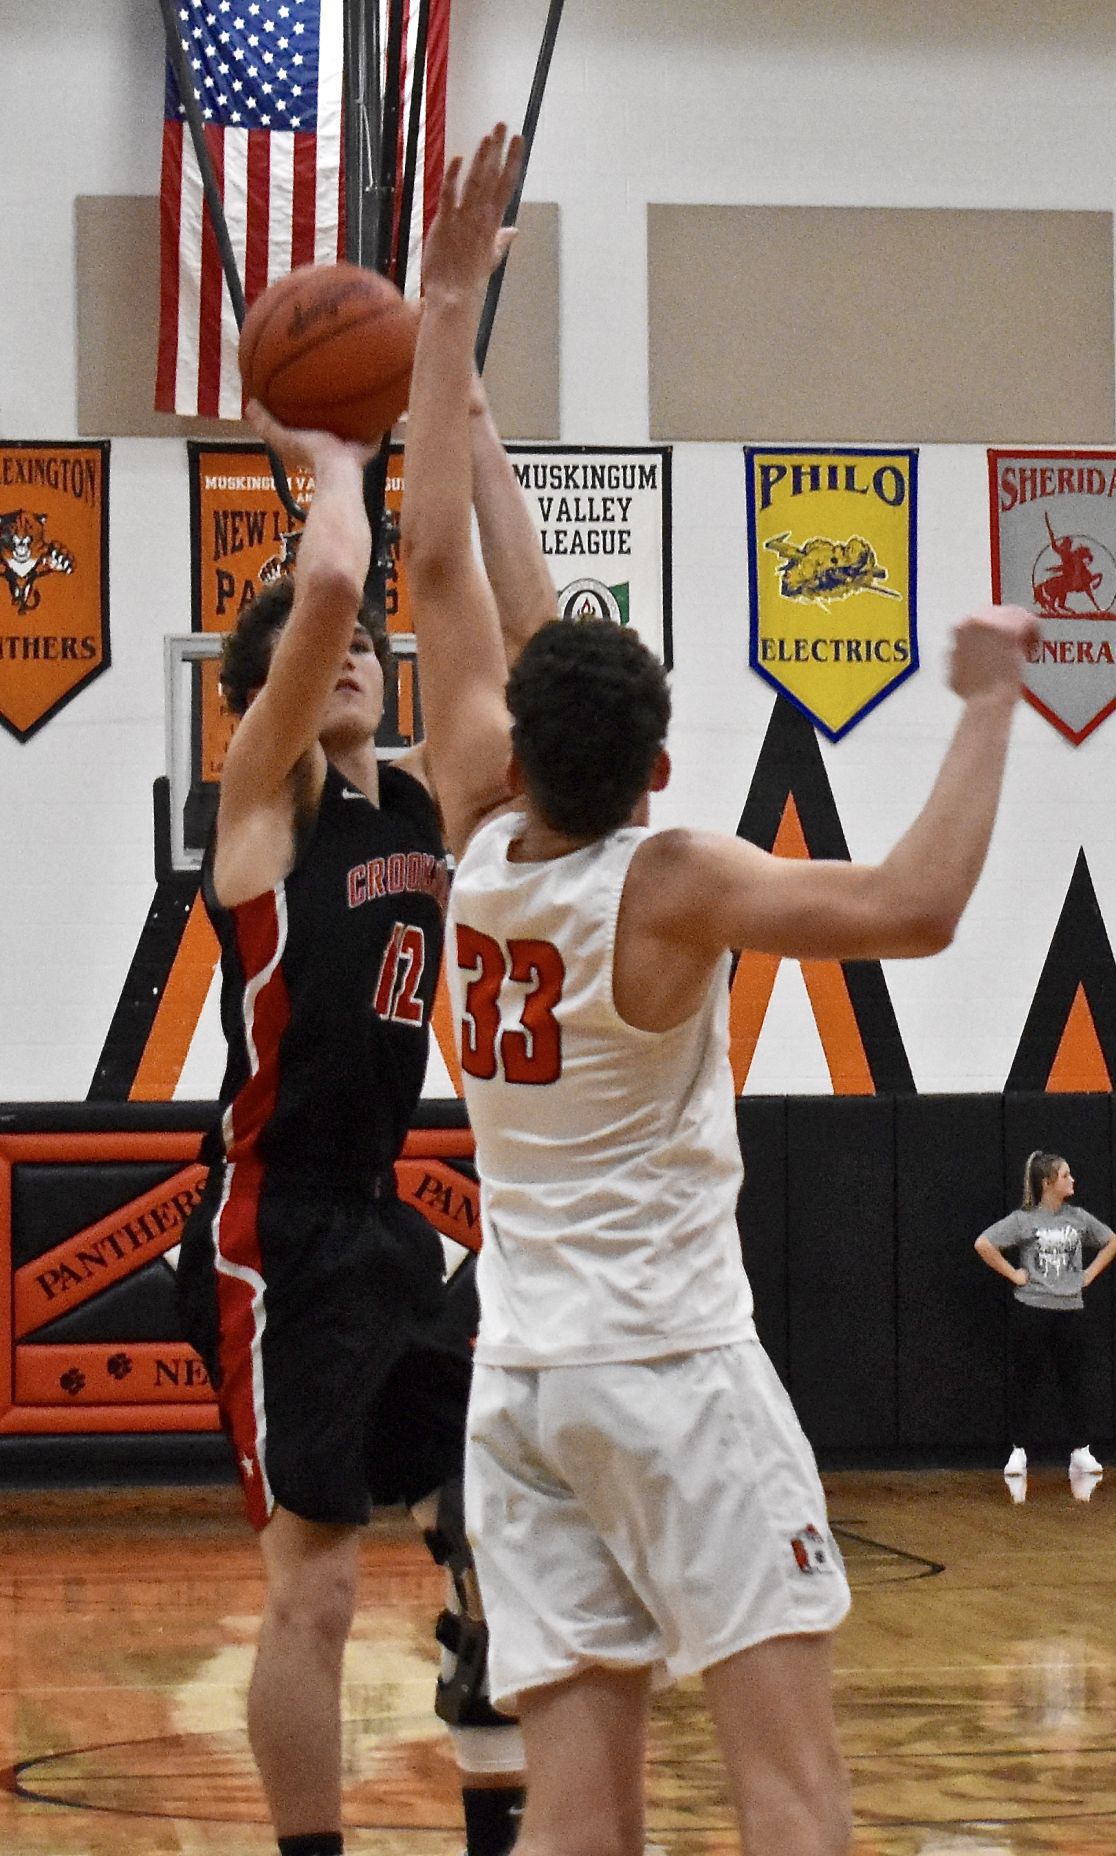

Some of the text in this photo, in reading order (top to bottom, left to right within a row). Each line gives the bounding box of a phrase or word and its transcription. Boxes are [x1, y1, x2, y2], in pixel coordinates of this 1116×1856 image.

[0, 455, 97, 508] EXINGTON
[512, 463, 658, 490] MUSKINGUM
[759, 463, 906, 513] PHILO
[538, 497, 632, 523] VALLEY
[213, 510, 267, 561] NEW
[541, 529, 631, 556] LEAGUE
[760, 637, 909, 664] ELECTRICS
[374, 921, 425, 1029] 12
[456, 921, 566, 1086] 33
